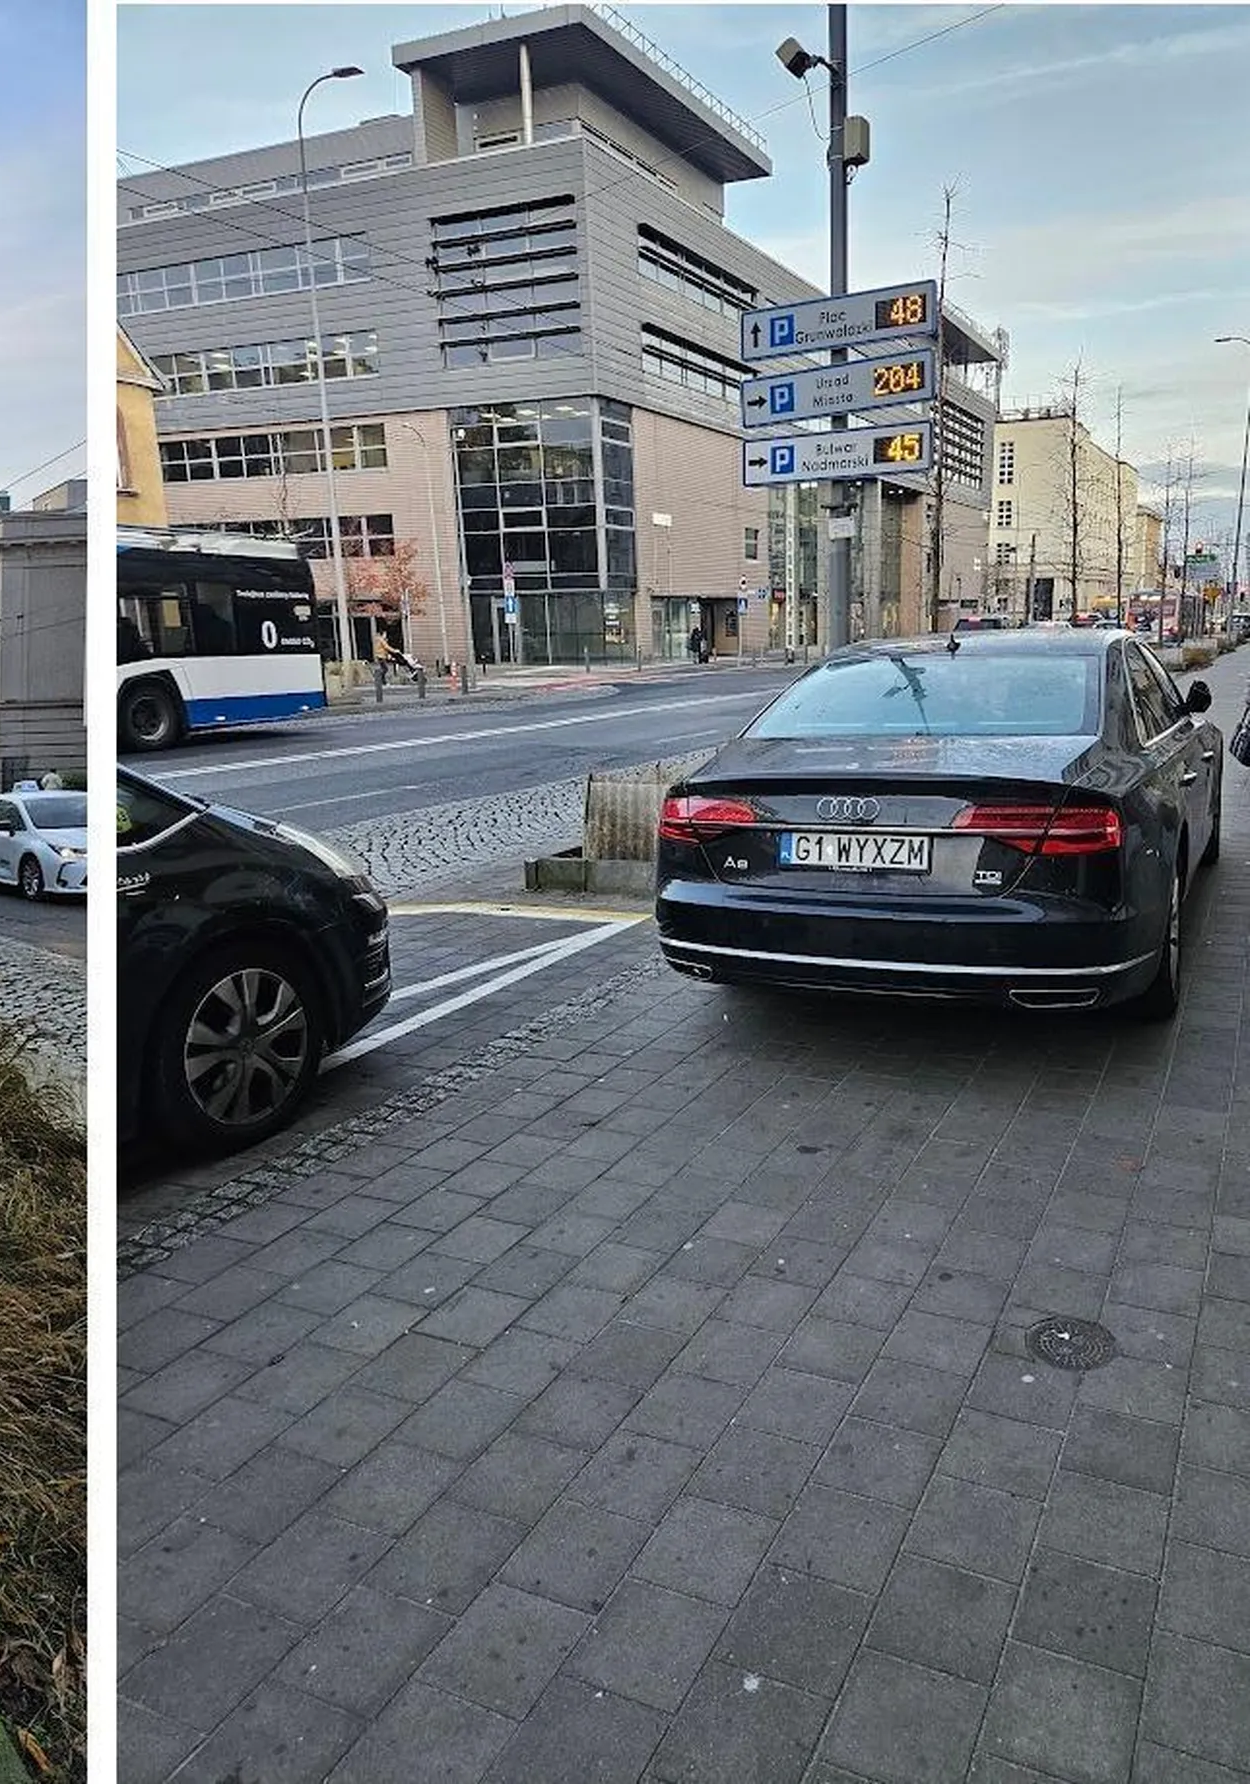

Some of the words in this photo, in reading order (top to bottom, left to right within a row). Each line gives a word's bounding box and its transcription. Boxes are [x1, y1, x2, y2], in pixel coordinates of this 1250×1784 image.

[890, 295, 923, 325] 48
[818, 311, 848, 325] Plac
[812, 393, 853, 408] Miasta
[815, 442, 858, 456] Bulwar
[888, 432, 921, 461] 45
[795, 836, 824, 862] G1
[837, 836, 925, 866] WYXZM
[723, 855, 749, 870] A8
[975, 870, 1003, 881] TDI
